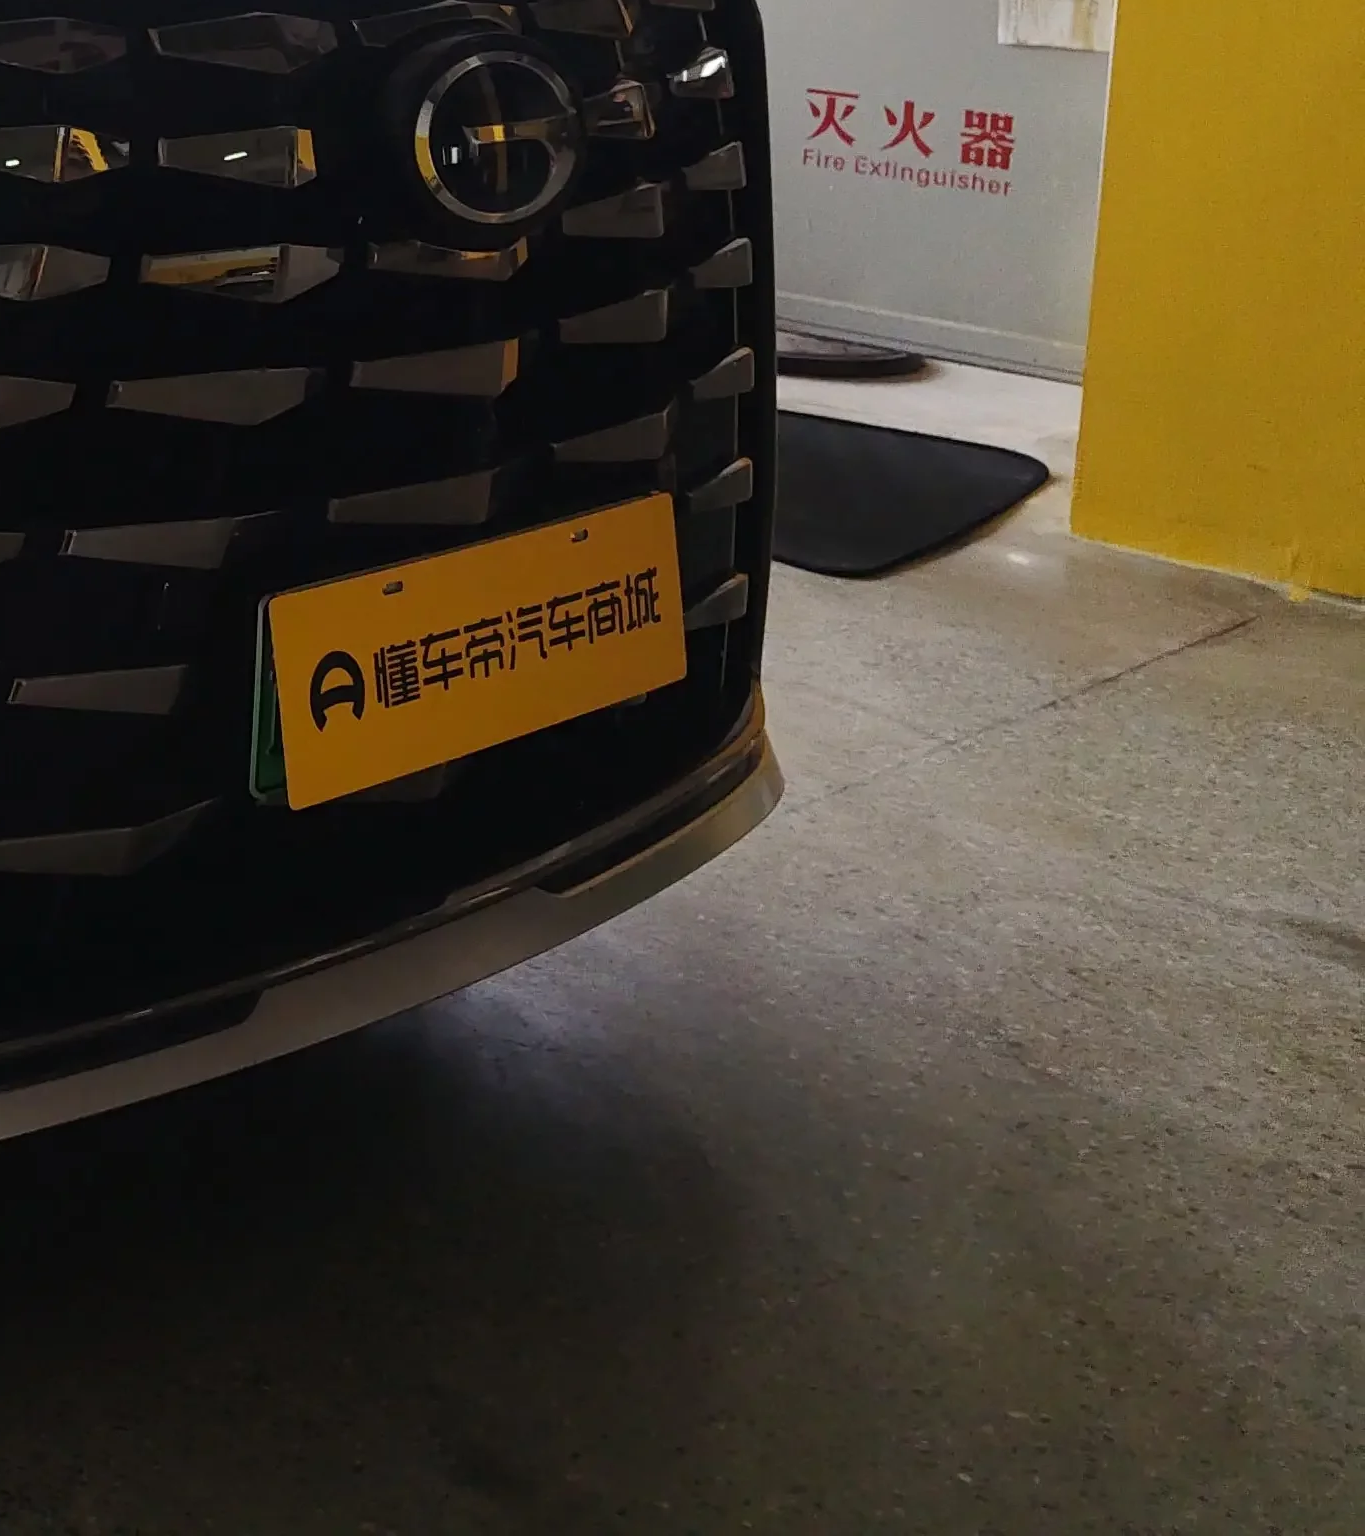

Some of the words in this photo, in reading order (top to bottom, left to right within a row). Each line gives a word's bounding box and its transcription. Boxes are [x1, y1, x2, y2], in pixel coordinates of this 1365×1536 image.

[805, 88, 1016, 171] 灭火器
[802, 148, 846, 172] Fire
[853, 154, 1013, 197] Extinguisher
[372, 566, 662, 710] 懂车帝汽车商城
